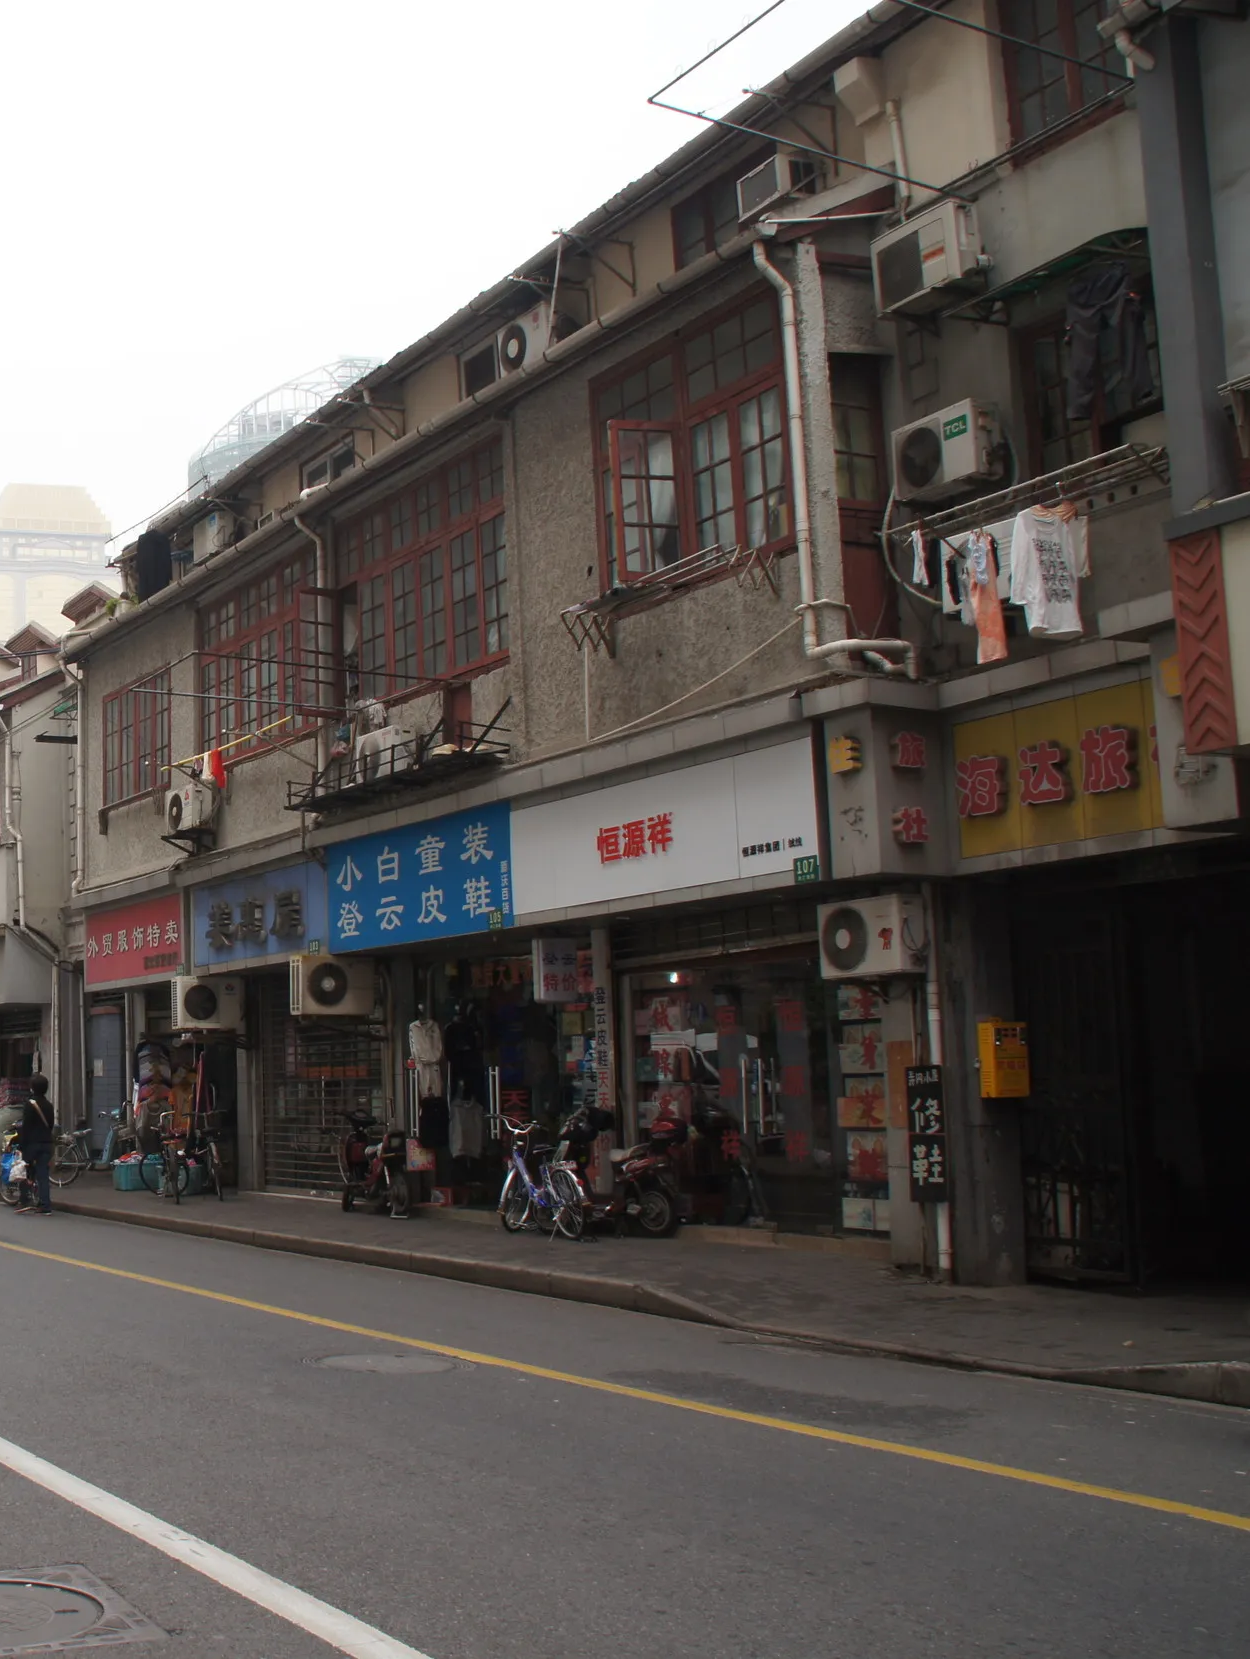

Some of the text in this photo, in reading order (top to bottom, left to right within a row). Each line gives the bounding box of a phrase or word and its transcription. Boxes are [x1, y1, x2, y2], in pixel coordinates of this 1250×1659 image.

[944, 419, 967, 436] TCL
[891, 730, 929, 844] 旅社
[956, 724, 1160, 819] 海达旅
[336, 821, 494, 892] 小白童装
[596, 811, 674, 865] 恒源祥
[796, 858, 815, 875] 107
[87, 919, 180, 959] 外贸服饰特卖
[337, 875, 495, 940] 登云皮鞋
[543, 972, 577, 991] 特价
[596, 986, 609, 1067] 登云皮鞋
[910, 1097, 945, 1186] 修鞋
